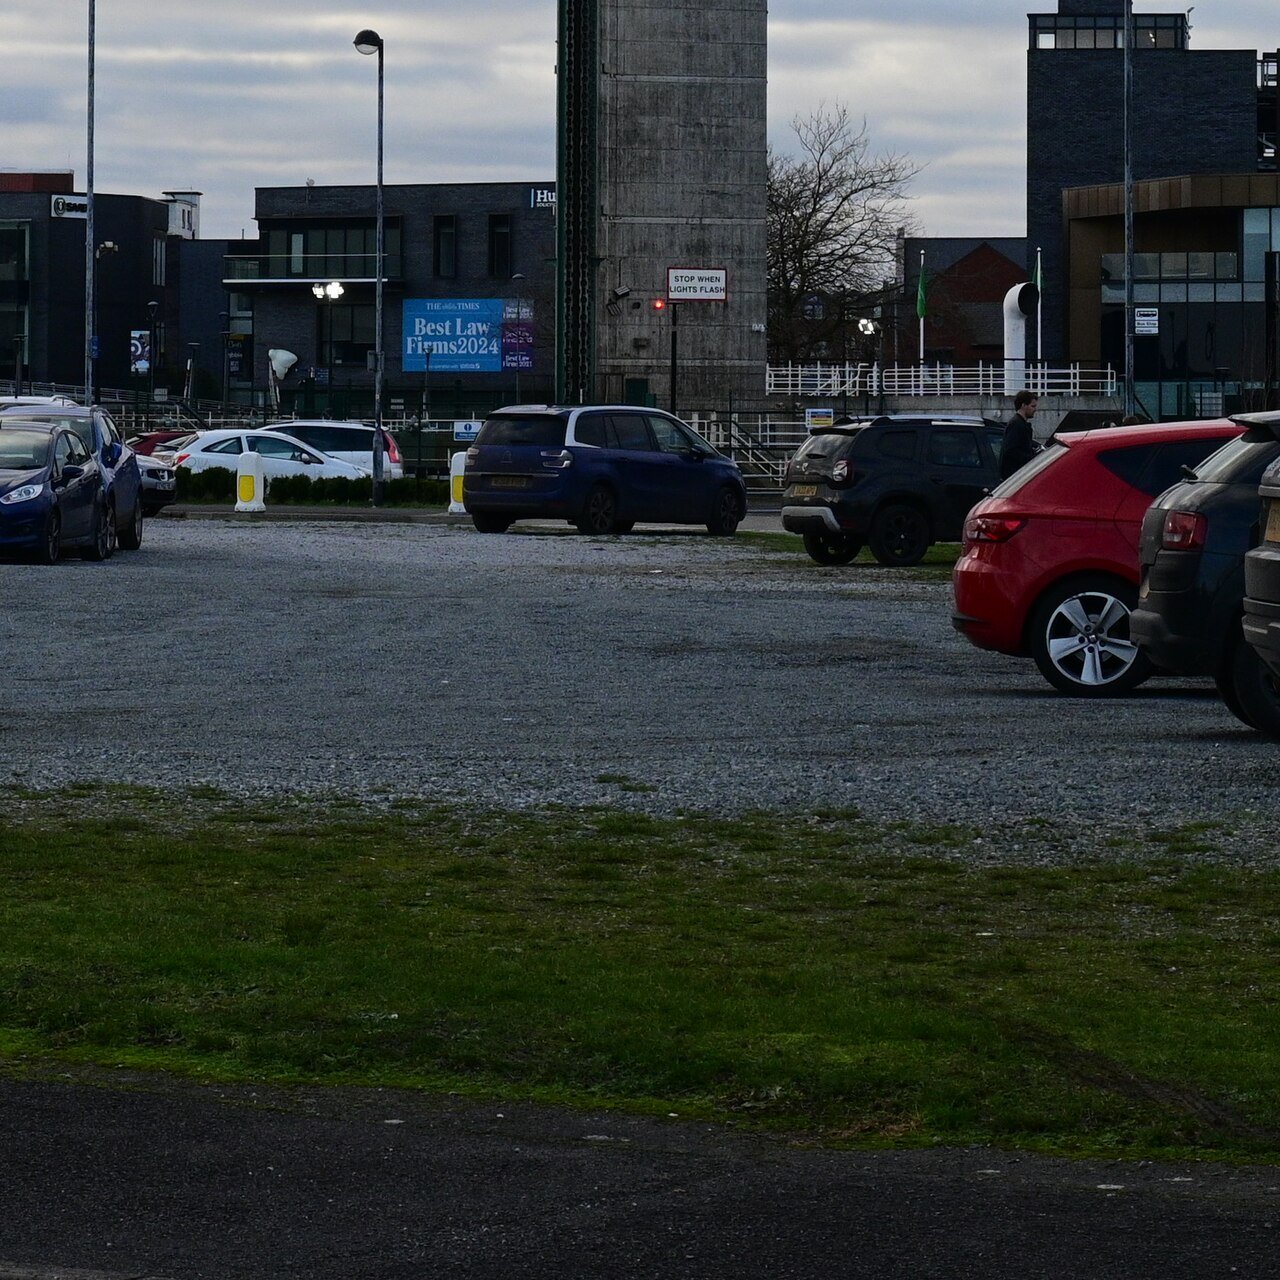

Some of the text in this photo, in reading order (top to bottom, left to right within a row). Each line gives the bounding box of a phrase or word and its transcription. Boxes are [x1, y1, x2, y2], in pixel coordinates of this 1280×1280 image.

[674, 275, 721, 283] STOP WHEN
[670, 285, 725, 293] LIGHTS FLASH
[458, 302, 480, 310] TIMES
[414, 318, 496, 336] Best Law
